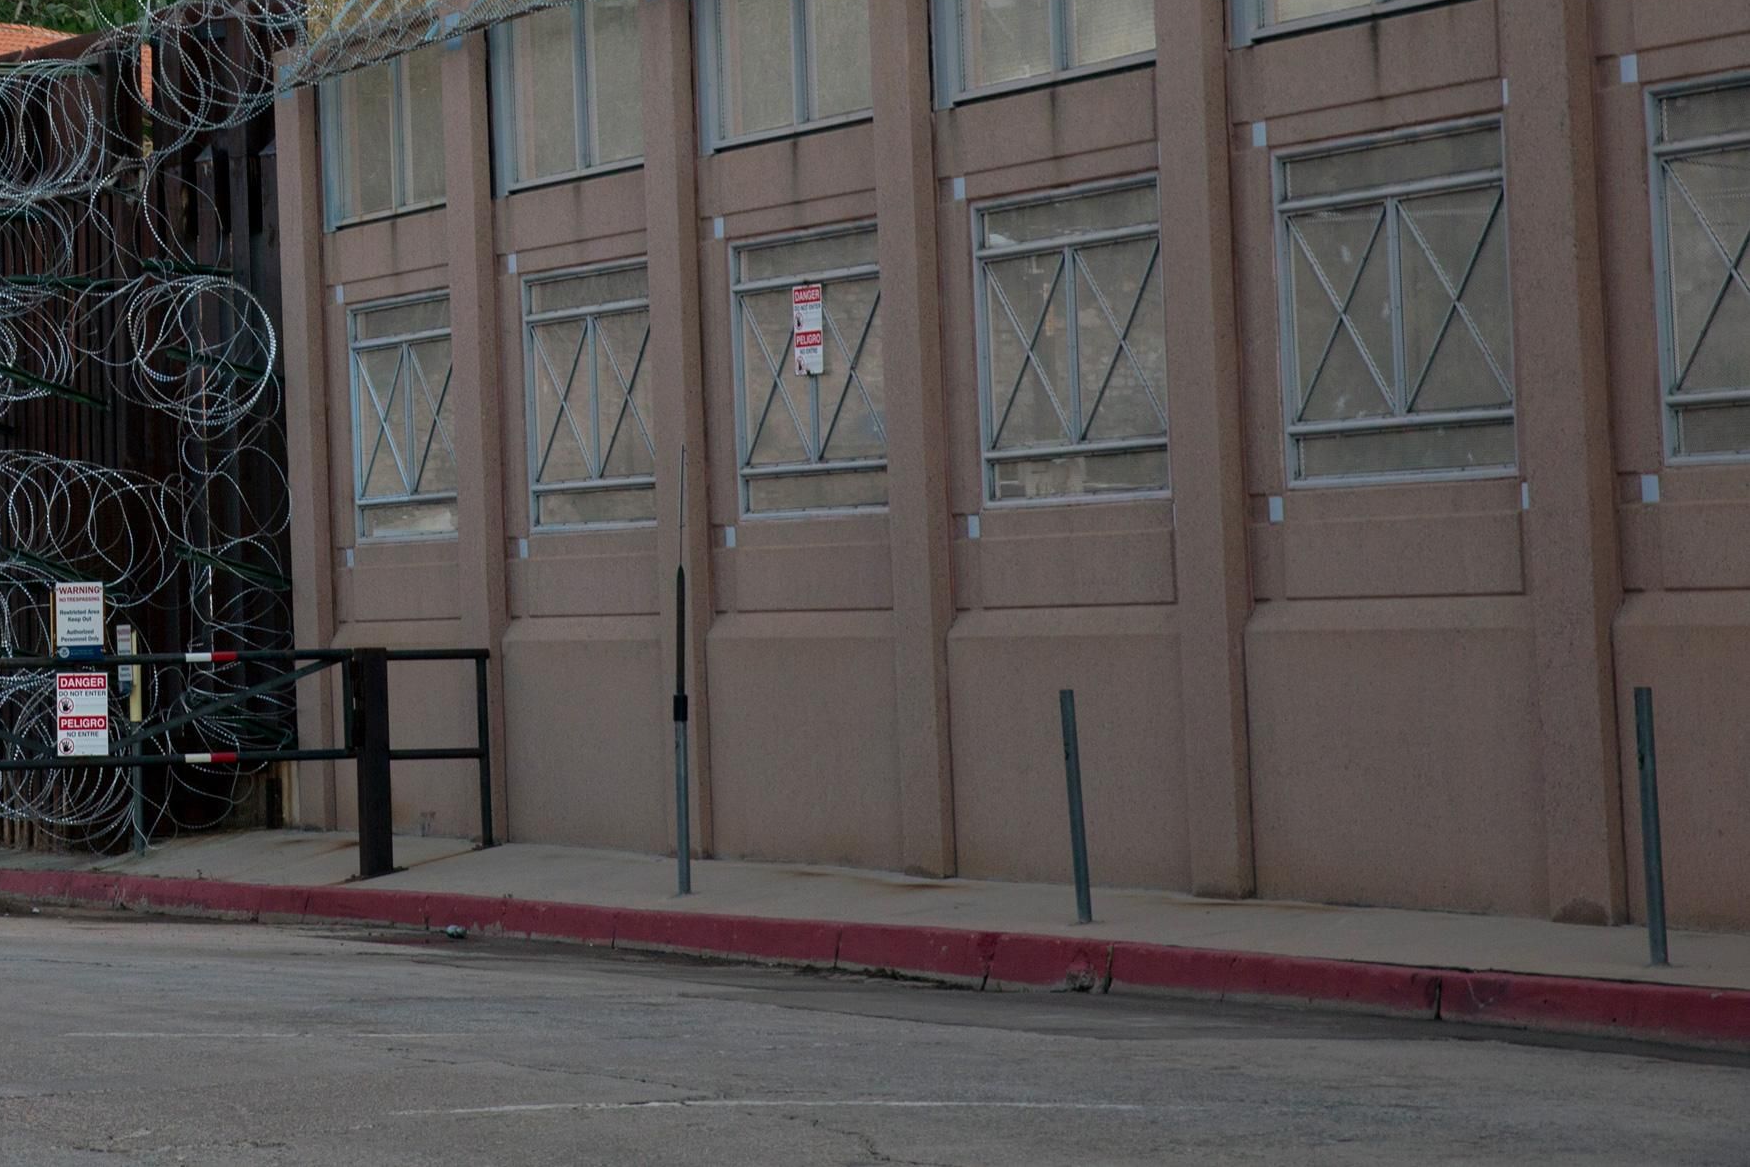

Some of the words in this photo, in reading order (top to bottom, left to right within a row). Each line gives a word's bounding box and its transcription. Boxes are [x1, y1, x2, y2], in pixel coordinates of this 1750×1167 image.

[794, 289, 820, 301] DANGER
[796, 334, 820, 345] PELIGRO
[59, 586, 100, 594] WARNING
[60, 677, 105, 688] DANGER
[60, 718, 105, 729] PELIGRO
